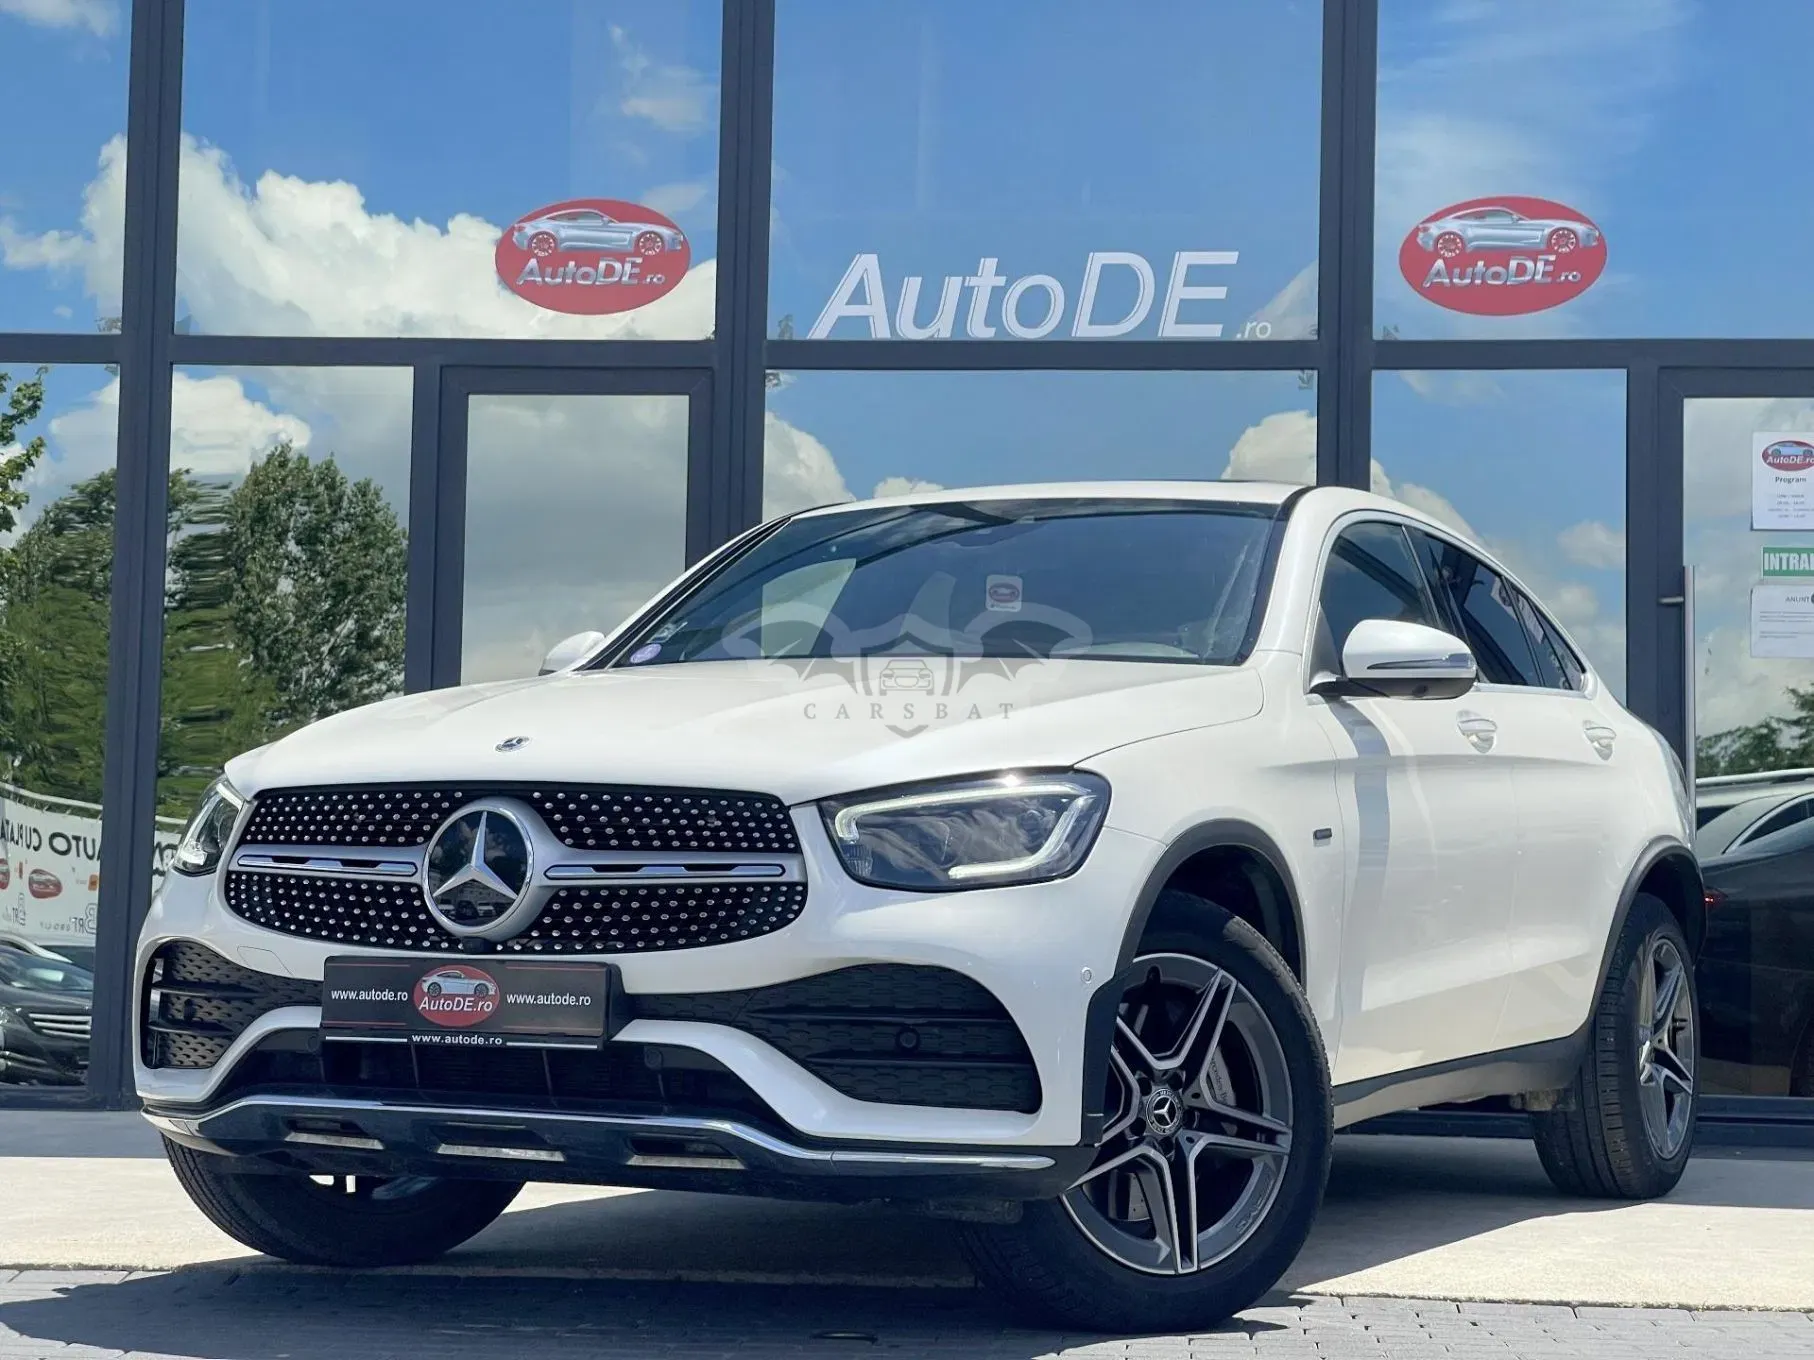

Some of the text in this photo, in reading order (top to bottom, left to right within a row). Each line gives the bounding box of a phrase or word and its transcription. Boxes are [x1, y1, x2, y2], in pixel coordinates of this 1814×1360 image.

[1775, 476, 1807, 484] Program
[331, 988, 408, 1001] www.autode.ro
[506, 992, 592, 1006] www.autode.ro
[418, 996, 493, 1013] AutoDE.ro
[411, 1033, 503, 1046] www.autode.ro
